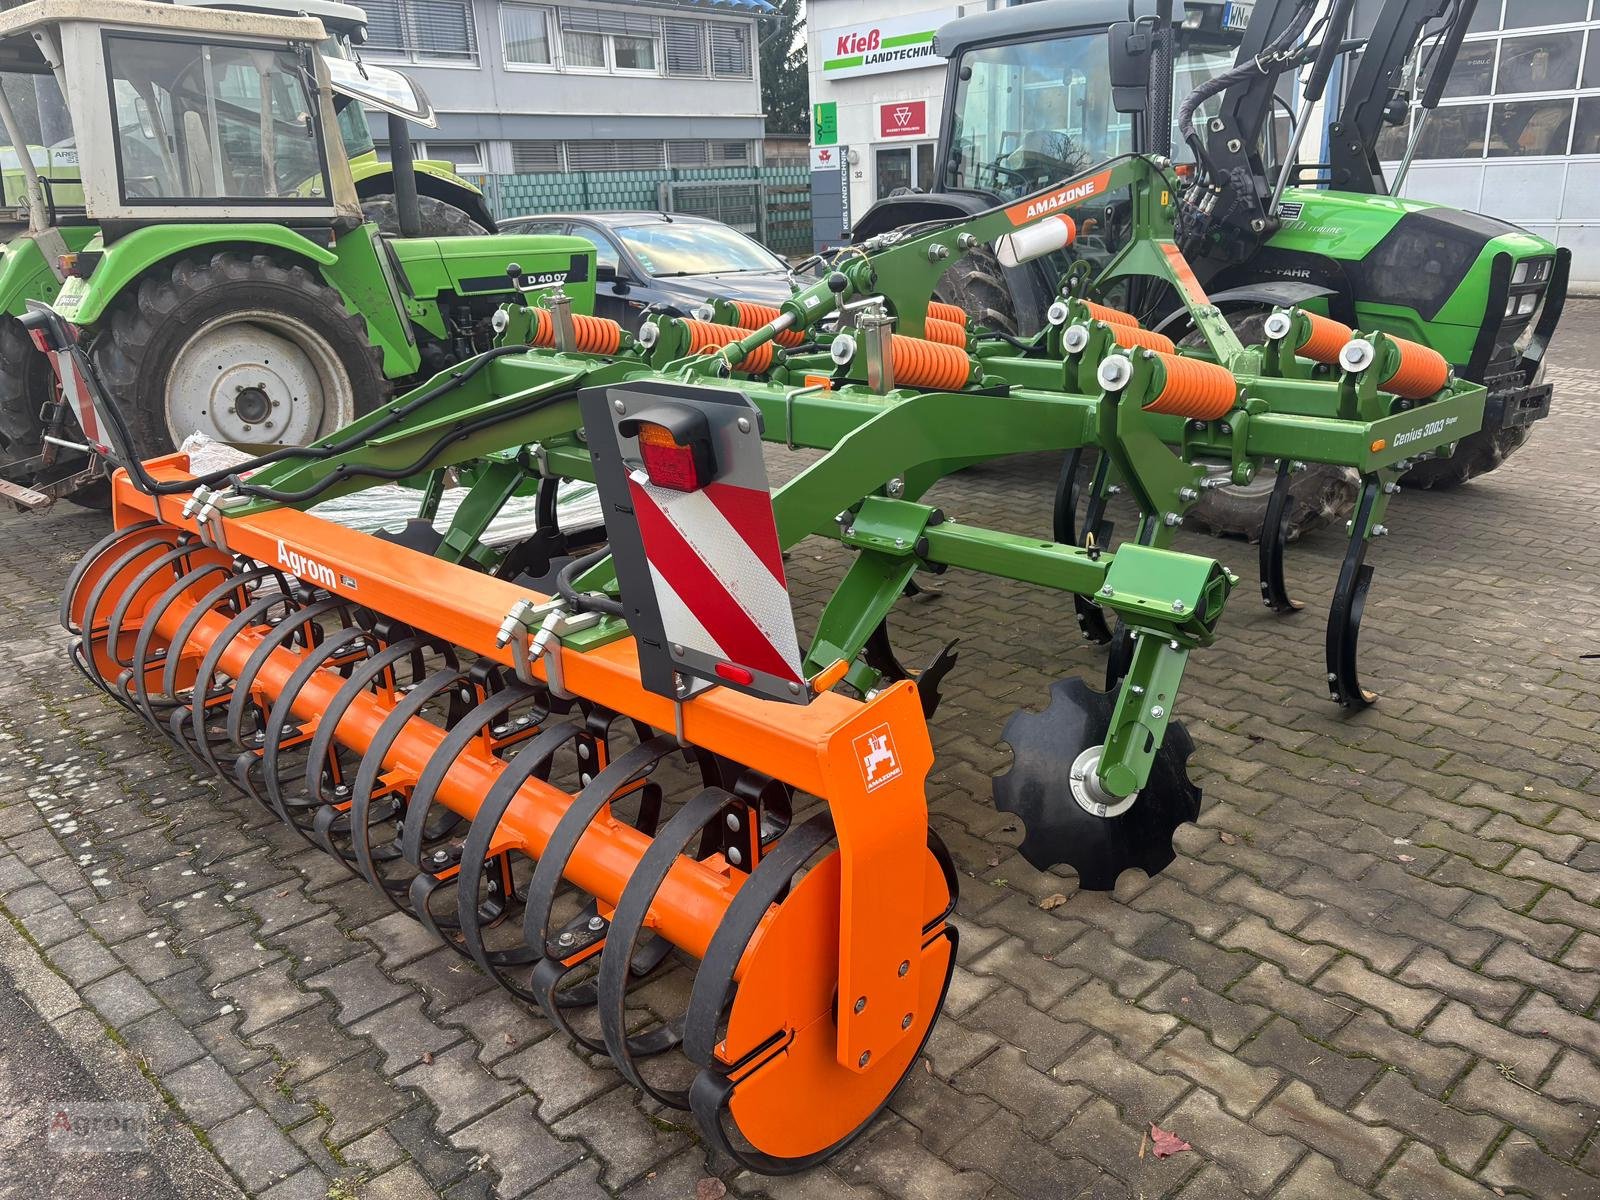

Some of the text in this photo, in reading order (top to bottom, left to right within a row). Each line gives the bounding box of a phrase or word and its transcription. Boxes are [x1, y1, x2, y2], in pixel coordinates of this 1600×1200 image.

[836, 29, 880, 56] Kieß
[854, 171, 863, 179] 32
[1026, 181, 1095, 218] AMAZONE
[527, 275, 536, 285] D
[1423, 419, 1445, 438] 3003
[277, 539, 337, 589] Agrom
[867, 767, 901, 790] AMAZONE
